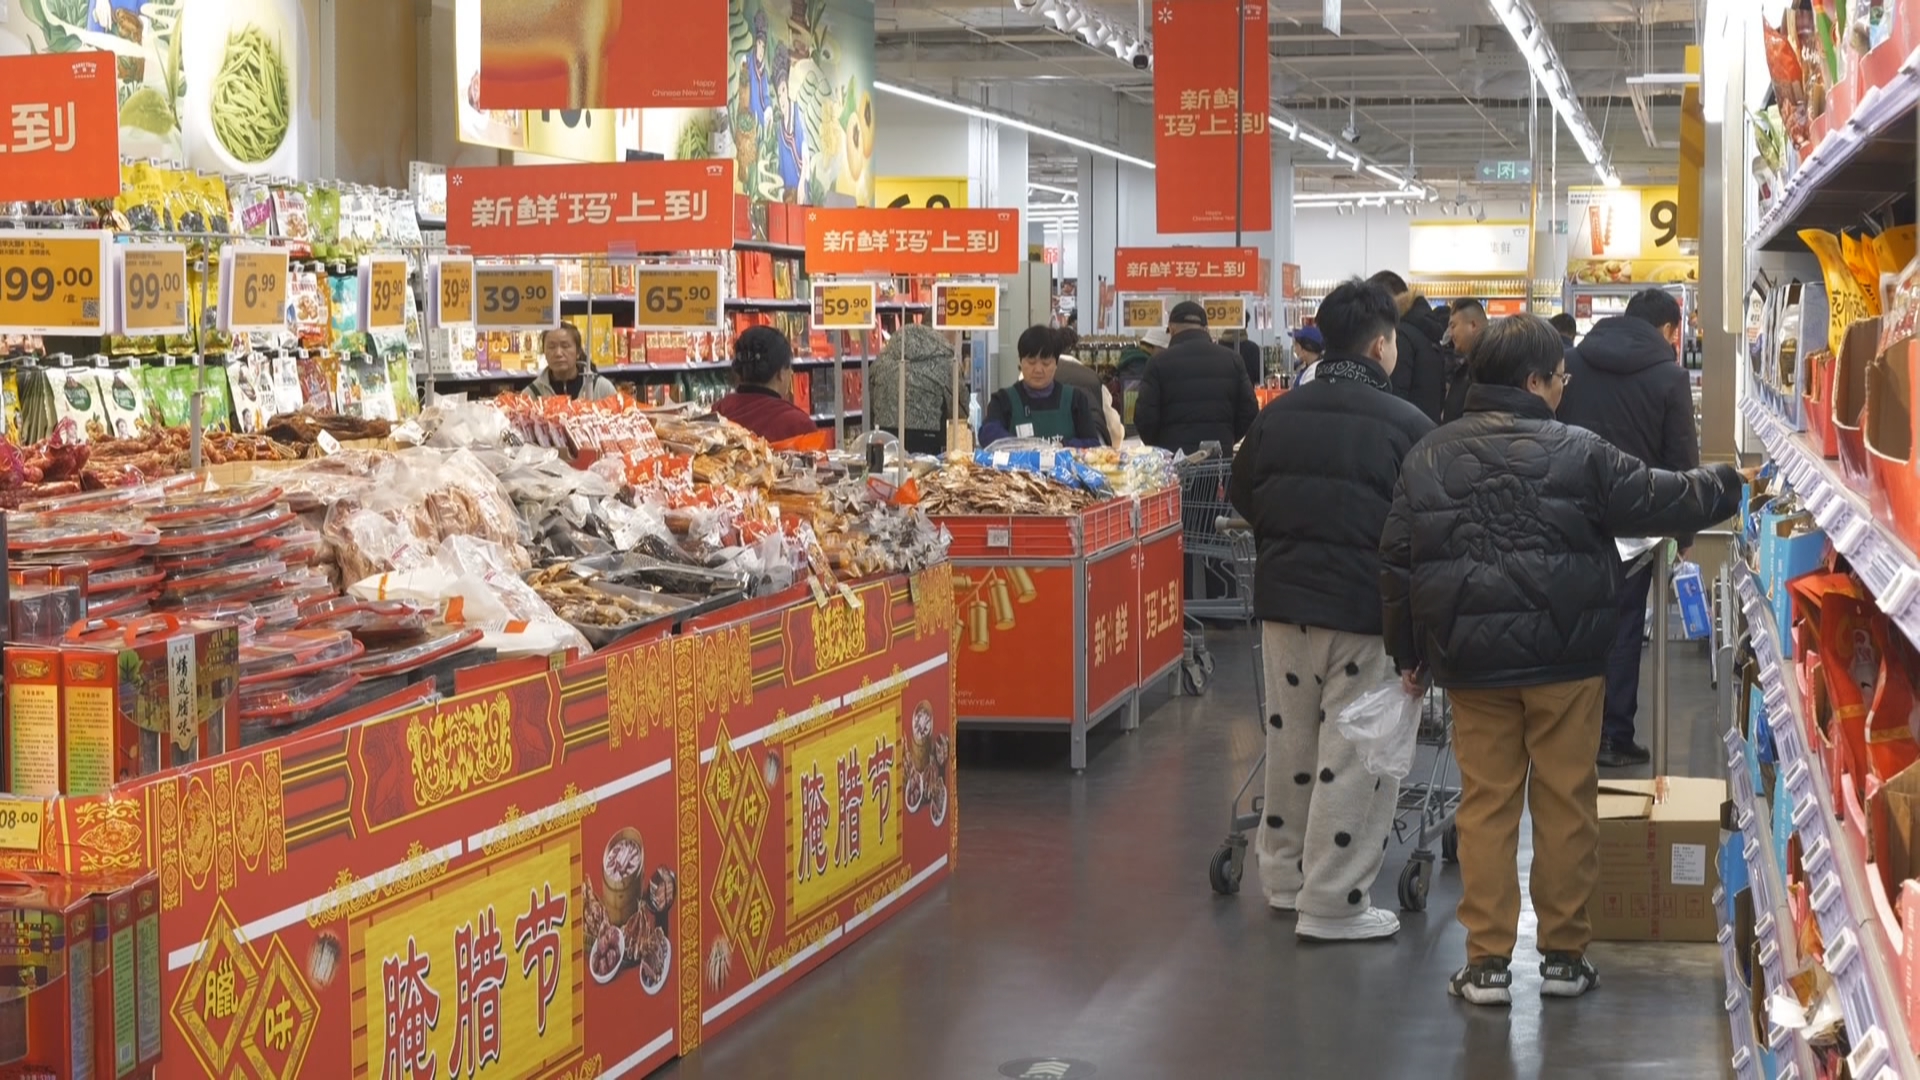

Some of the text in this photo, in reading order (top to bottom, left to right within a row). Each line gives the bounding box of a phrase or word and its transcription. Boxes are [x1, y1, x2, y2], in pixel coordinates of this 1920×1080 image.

[652, 88, 717, 98] Chinese New Year
[692, 79, 717, 87] Happy
[0, 101, 76, 155] 到
[129, 272, 181, 310] 99.00
[244, 273, 275, 308] 6.99
[373, 279, 403, 311] 39.90
[443, 278, 469, 308] 39.99
[483, 285, 547, 312] 39.90
[646, 285, 711, 313] 65.90
[824, 298, 868, 316] 59.90
[946, 299, 992, 317] 99.90
[1094, 601, 1128, 667] 新鲜
[797, 733, 894, 885] 腌腊节
[1489, 973, 1507, 983] NIKE
[1545, 966, 1563, 976] NIKE
